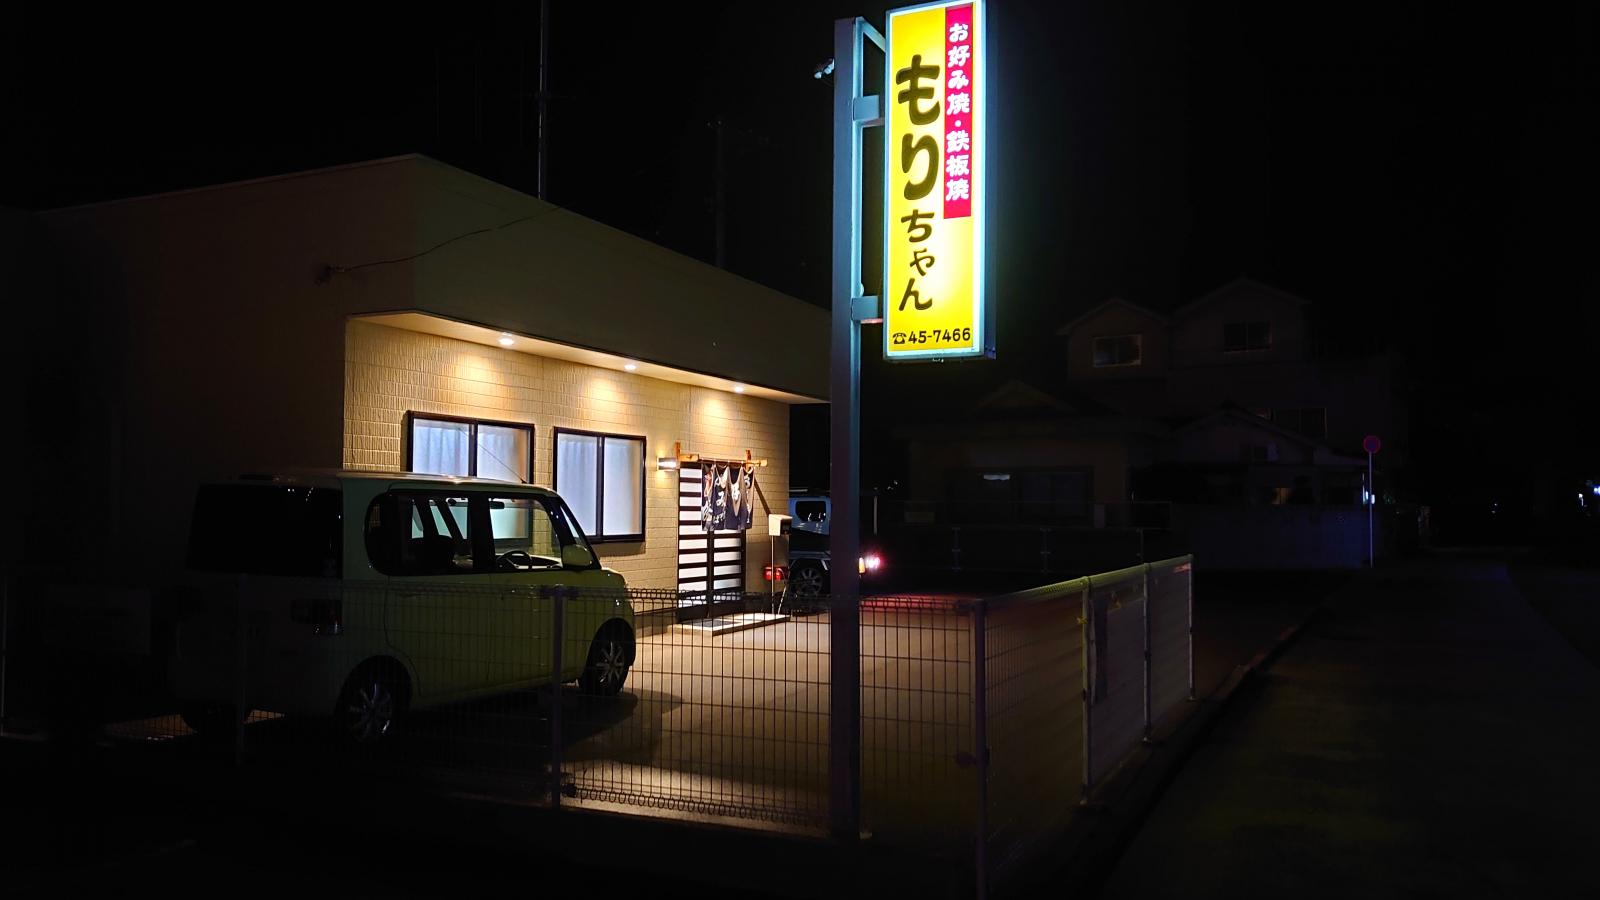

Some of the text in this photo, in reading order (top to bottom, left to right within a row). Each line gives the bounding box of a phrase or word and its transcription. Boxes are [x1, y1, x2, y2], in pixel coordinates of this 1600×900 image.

[896, 54, 940, 311] もりちゃん
[946, 23, 970, 201] お好み焼・鉄板焼
[908, 327, 971, 344] 45-7466
